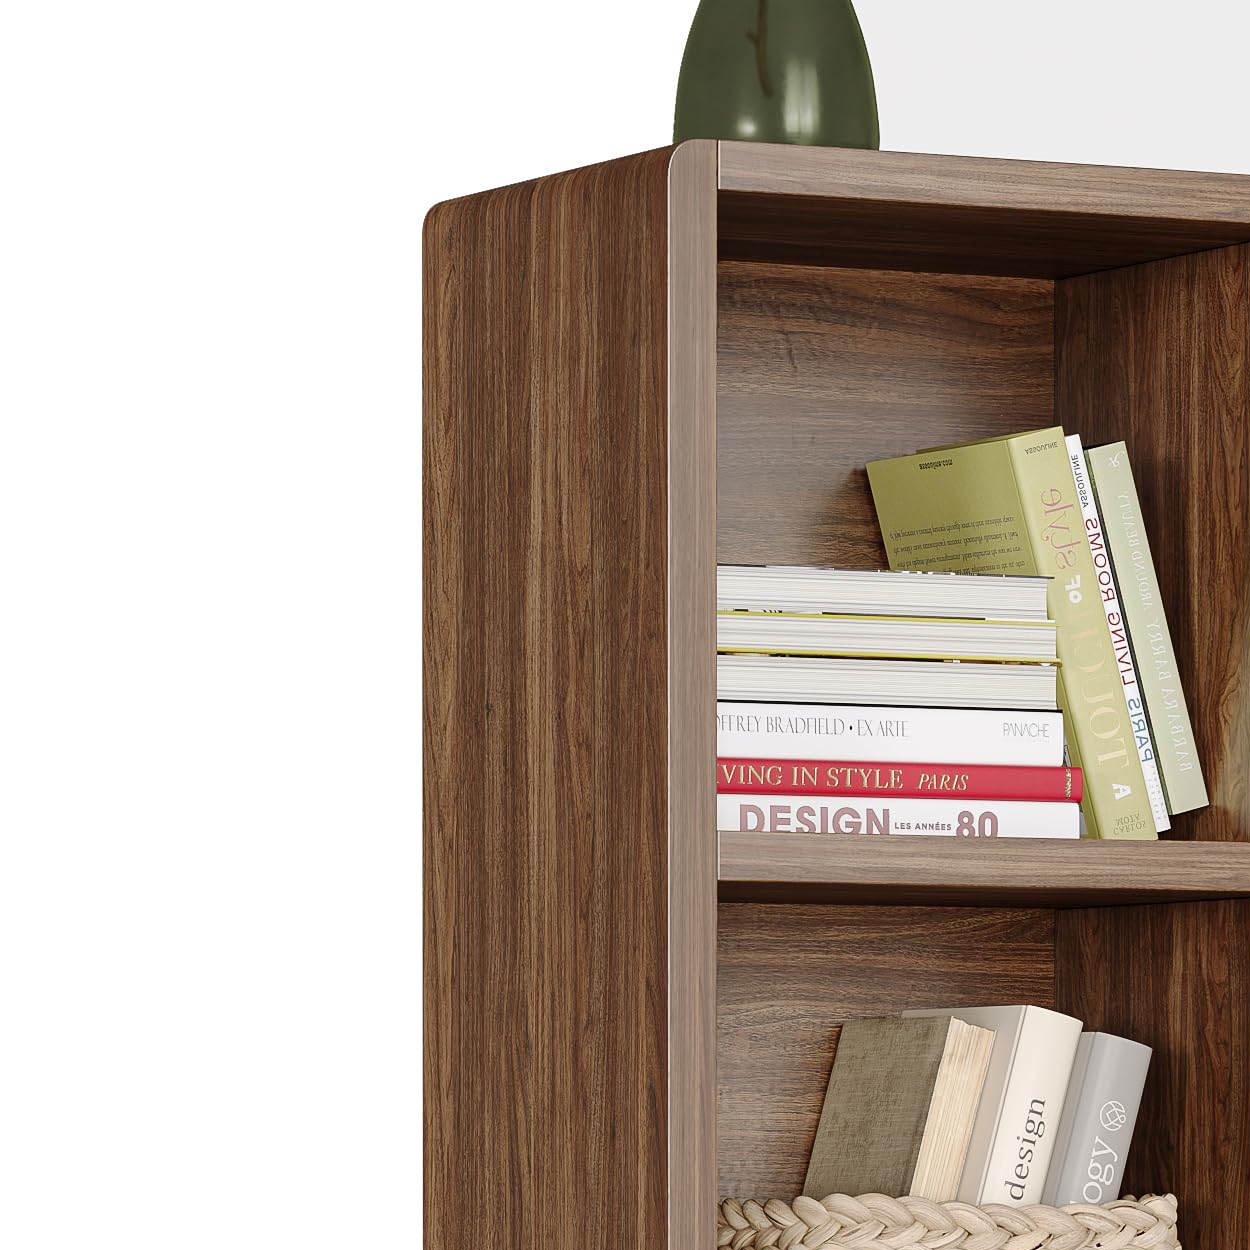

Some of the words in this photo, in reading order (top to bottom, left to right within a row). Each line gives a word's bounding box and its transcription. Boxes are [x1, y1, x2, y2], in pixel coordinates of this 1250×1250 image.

[766, 716, 845, 735] BRADFIELD
[857, 719, 873, 737] EX
[876, 720, 909, 738] ARTE
[1003, 723, 1050, 738] PANACHE
[717, 764, 782, 786] VING
[791, 766, 818, 787] IN
[826, 767, 904, 790] STYLE
[918, 773, 969, 791] PARIS
[740, 804, 890, 835] DESIGN
[894, 822, 911, 830] LES
[915, 821, 952, 831] ANNÉES
[956, 810, 999, 838] 80
[1004, 1099, 1046, 1201] design
[1074, 1136, 1118, 1204] ogy
